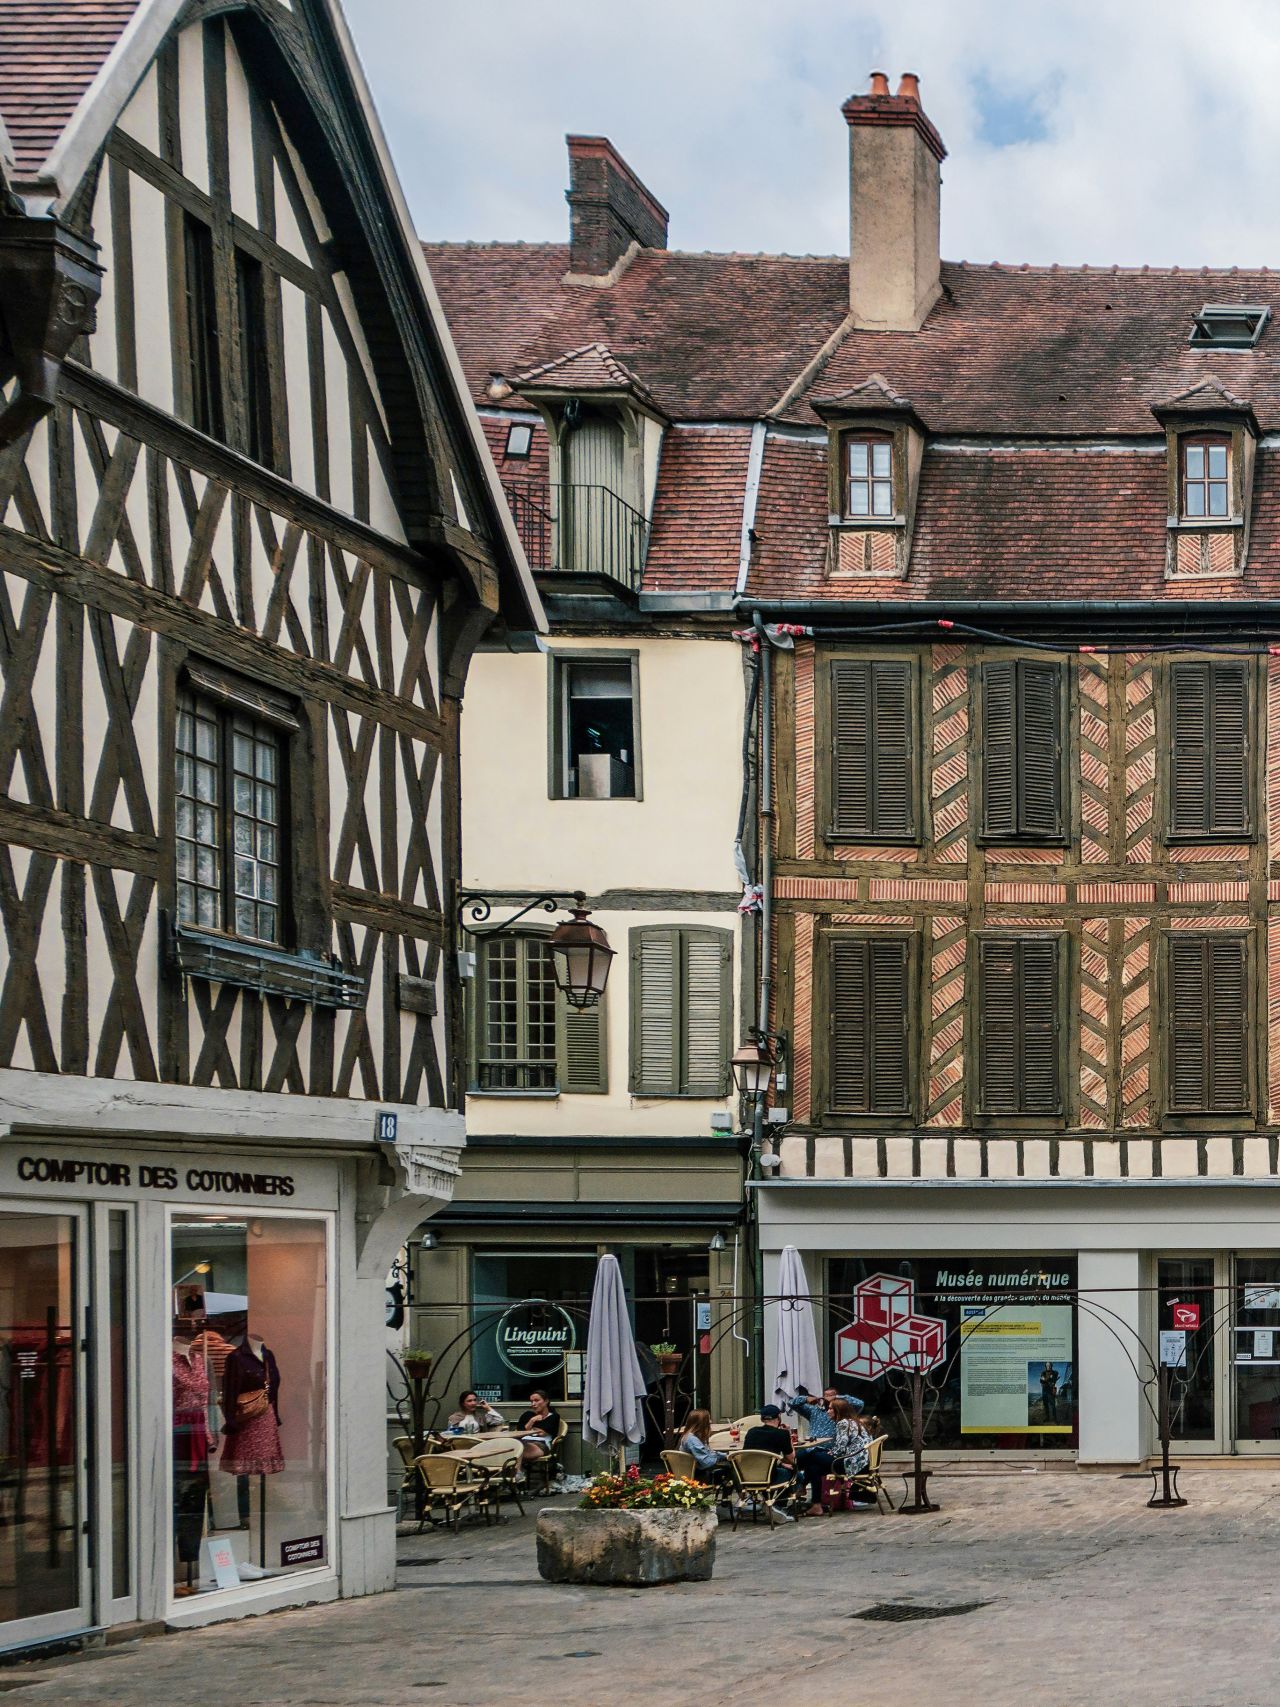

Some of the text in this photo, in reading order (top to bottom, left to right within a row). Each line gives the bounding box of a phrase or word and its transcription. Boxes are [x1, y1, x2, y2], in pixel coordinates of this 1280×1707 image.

[380, 1115, 395, 1139] 18
[17, 1156, 295, 1196] COMPTOIR DES COTONNIERS
[935, 1269, 1070, 1289] Musée numérique
[503, 1326, 568, 1345] Linguini
